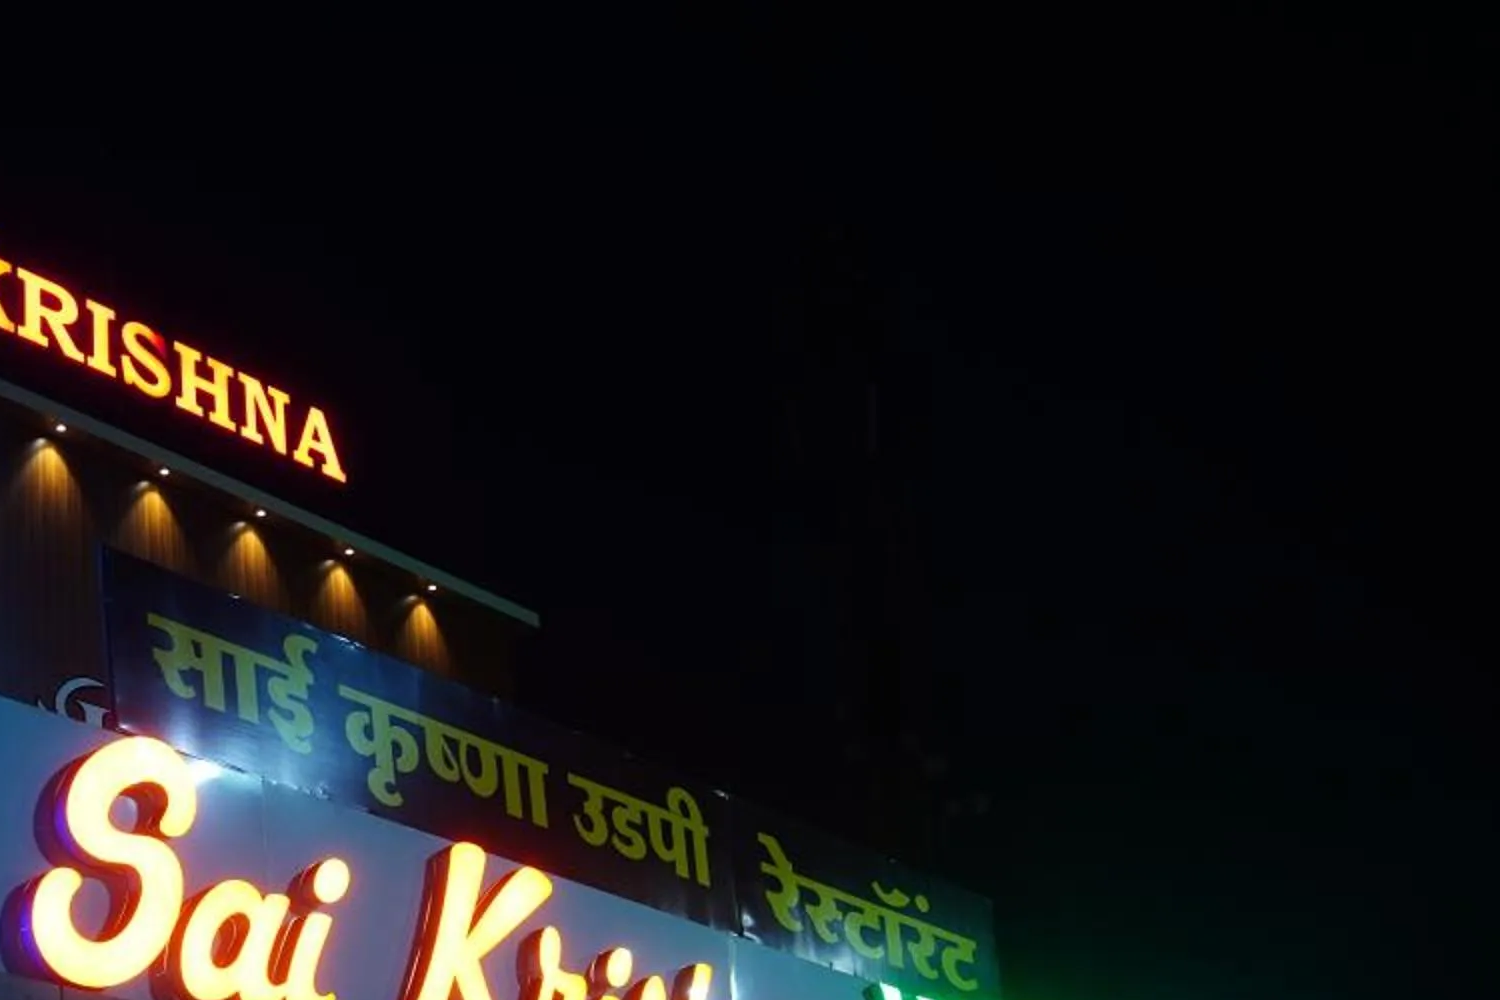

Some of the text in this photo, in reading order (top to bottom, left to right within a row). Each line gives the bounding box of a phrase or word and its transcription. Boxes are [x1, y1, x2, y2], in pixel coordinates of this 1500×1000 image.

[147, 611, 980, 992] साई कृष्णा उडपी रेस्टॉरंट
